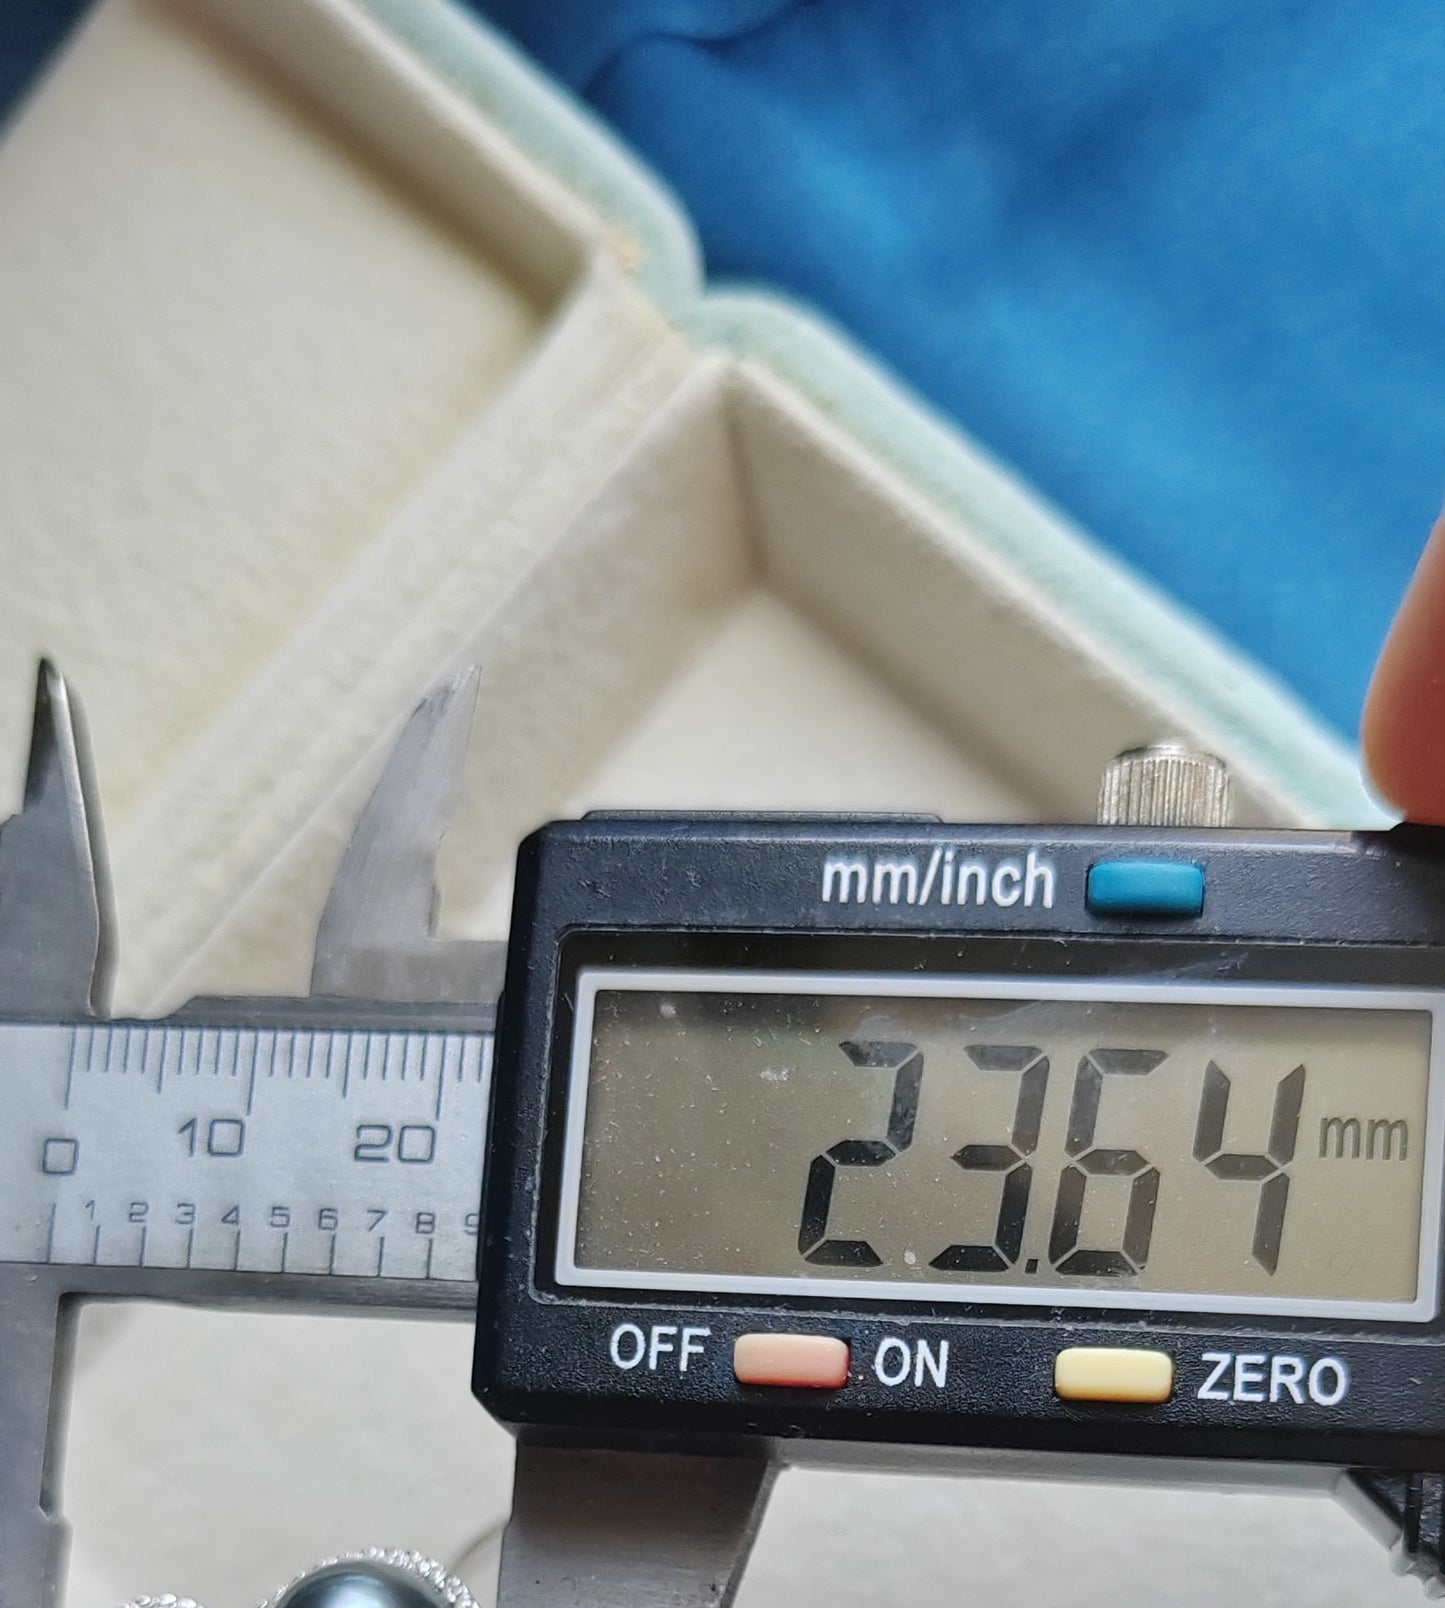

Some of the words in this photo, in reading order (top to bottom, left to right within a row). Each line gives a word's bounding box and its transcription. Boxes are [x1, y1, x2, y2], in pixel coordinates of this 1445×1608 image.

[821, 846, 1056, 910] mm/inch
[42, 1137, 79, 1175] 0
[177, 1117, 244, 1158] 10
[353, 1124, 436, 1163] 20
[798, 1040, 1306, 1277] 23.64
[1318, 1113, 1408, 1163] mm
[85, 1199, 96, 1220] 1
[128, 1201, 148, 1223] 2
[175, 1203, 196, 1225] 3
[220, 1204, 241, 1226] 4
[269, 1206, 291, 1228] 5
[317, 1208, 339, 1231] 6
[366, 1209, 386, 1232] 7
[414, 1211, 436, 1234] 8
[609, 1324, 711, 1373] OFF
[874, 1337, 949, 1389] ON
[1197, 1351, 1350, 1406] ZERO
